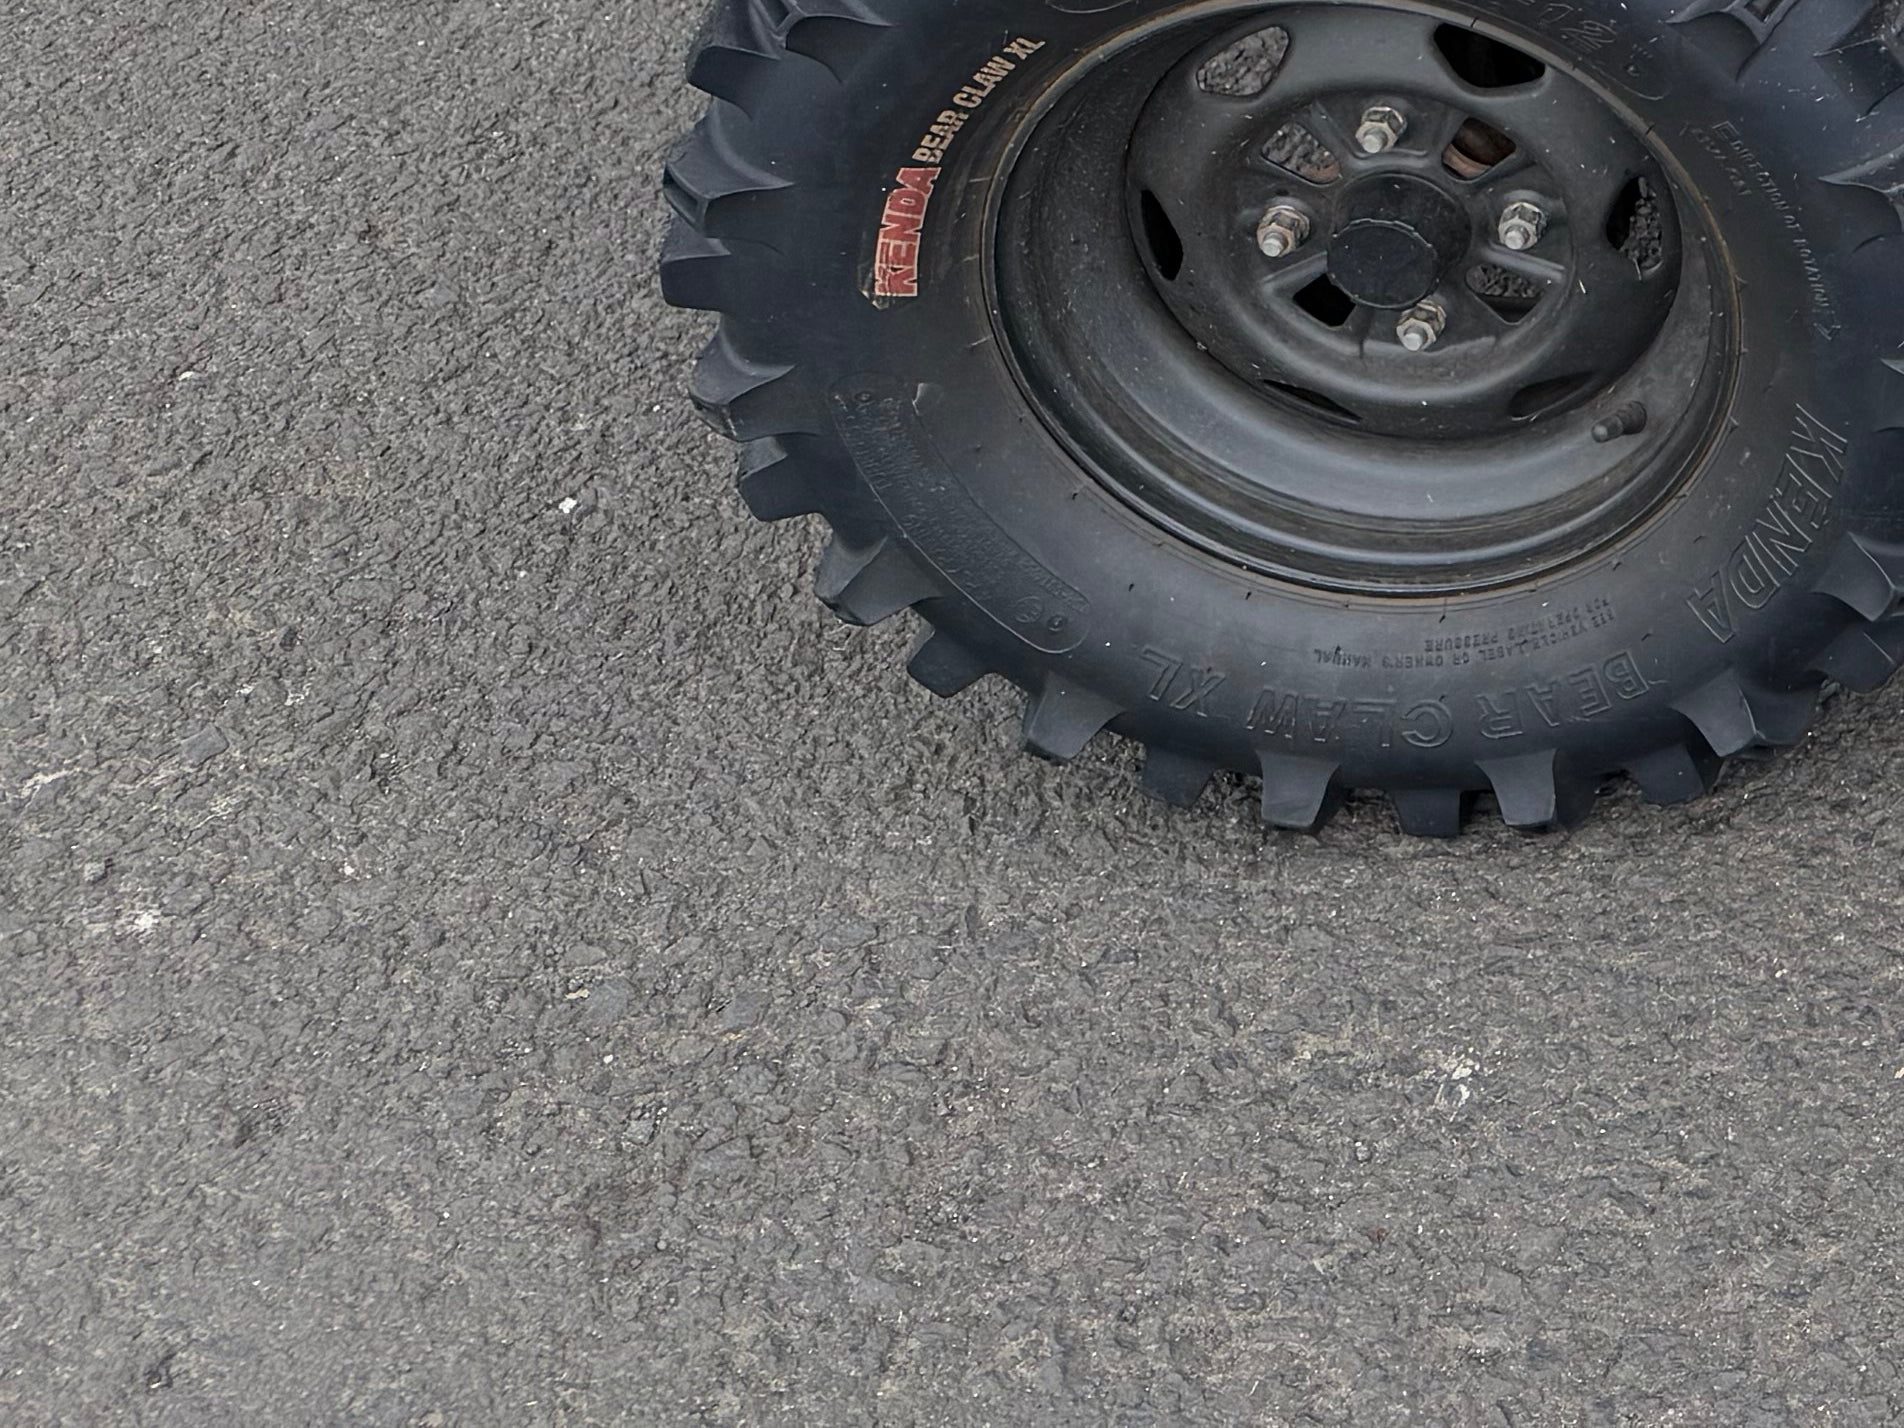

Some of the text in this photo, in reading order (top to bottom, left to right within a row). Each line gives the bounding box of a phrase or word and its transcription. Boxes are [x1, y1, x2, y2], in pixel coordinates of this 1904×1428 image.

[874, 37, 1046, 297] KENDA BEAR CLAW XL
[1140, 403, 1848, 748] KENDA BEAR CLAW XL
